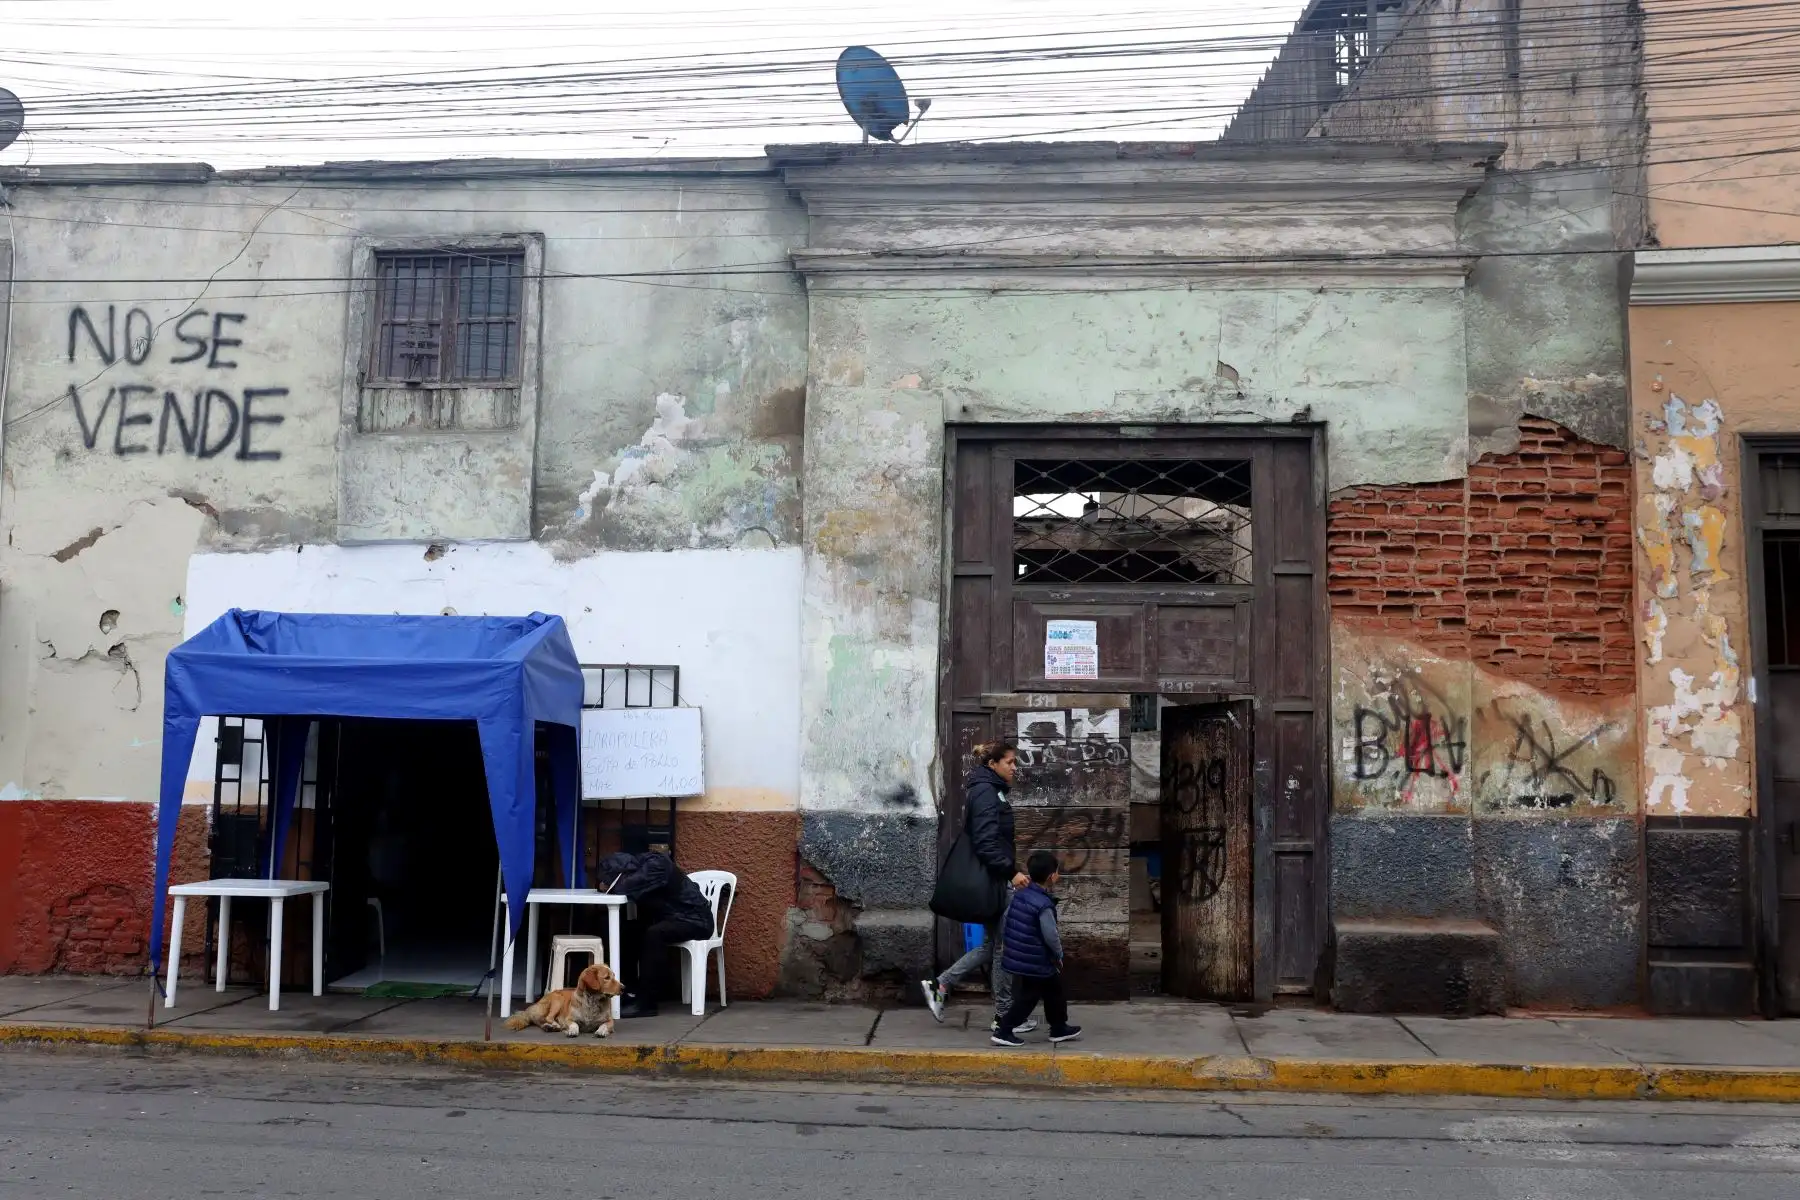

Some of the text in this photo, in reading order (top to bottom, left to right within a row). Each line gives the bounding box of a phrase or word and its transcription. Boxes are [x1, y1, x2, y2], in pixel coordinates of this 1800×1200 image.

[68, 305, 247, 369] NO SE
[68, 384, 289, 461] VENDE
